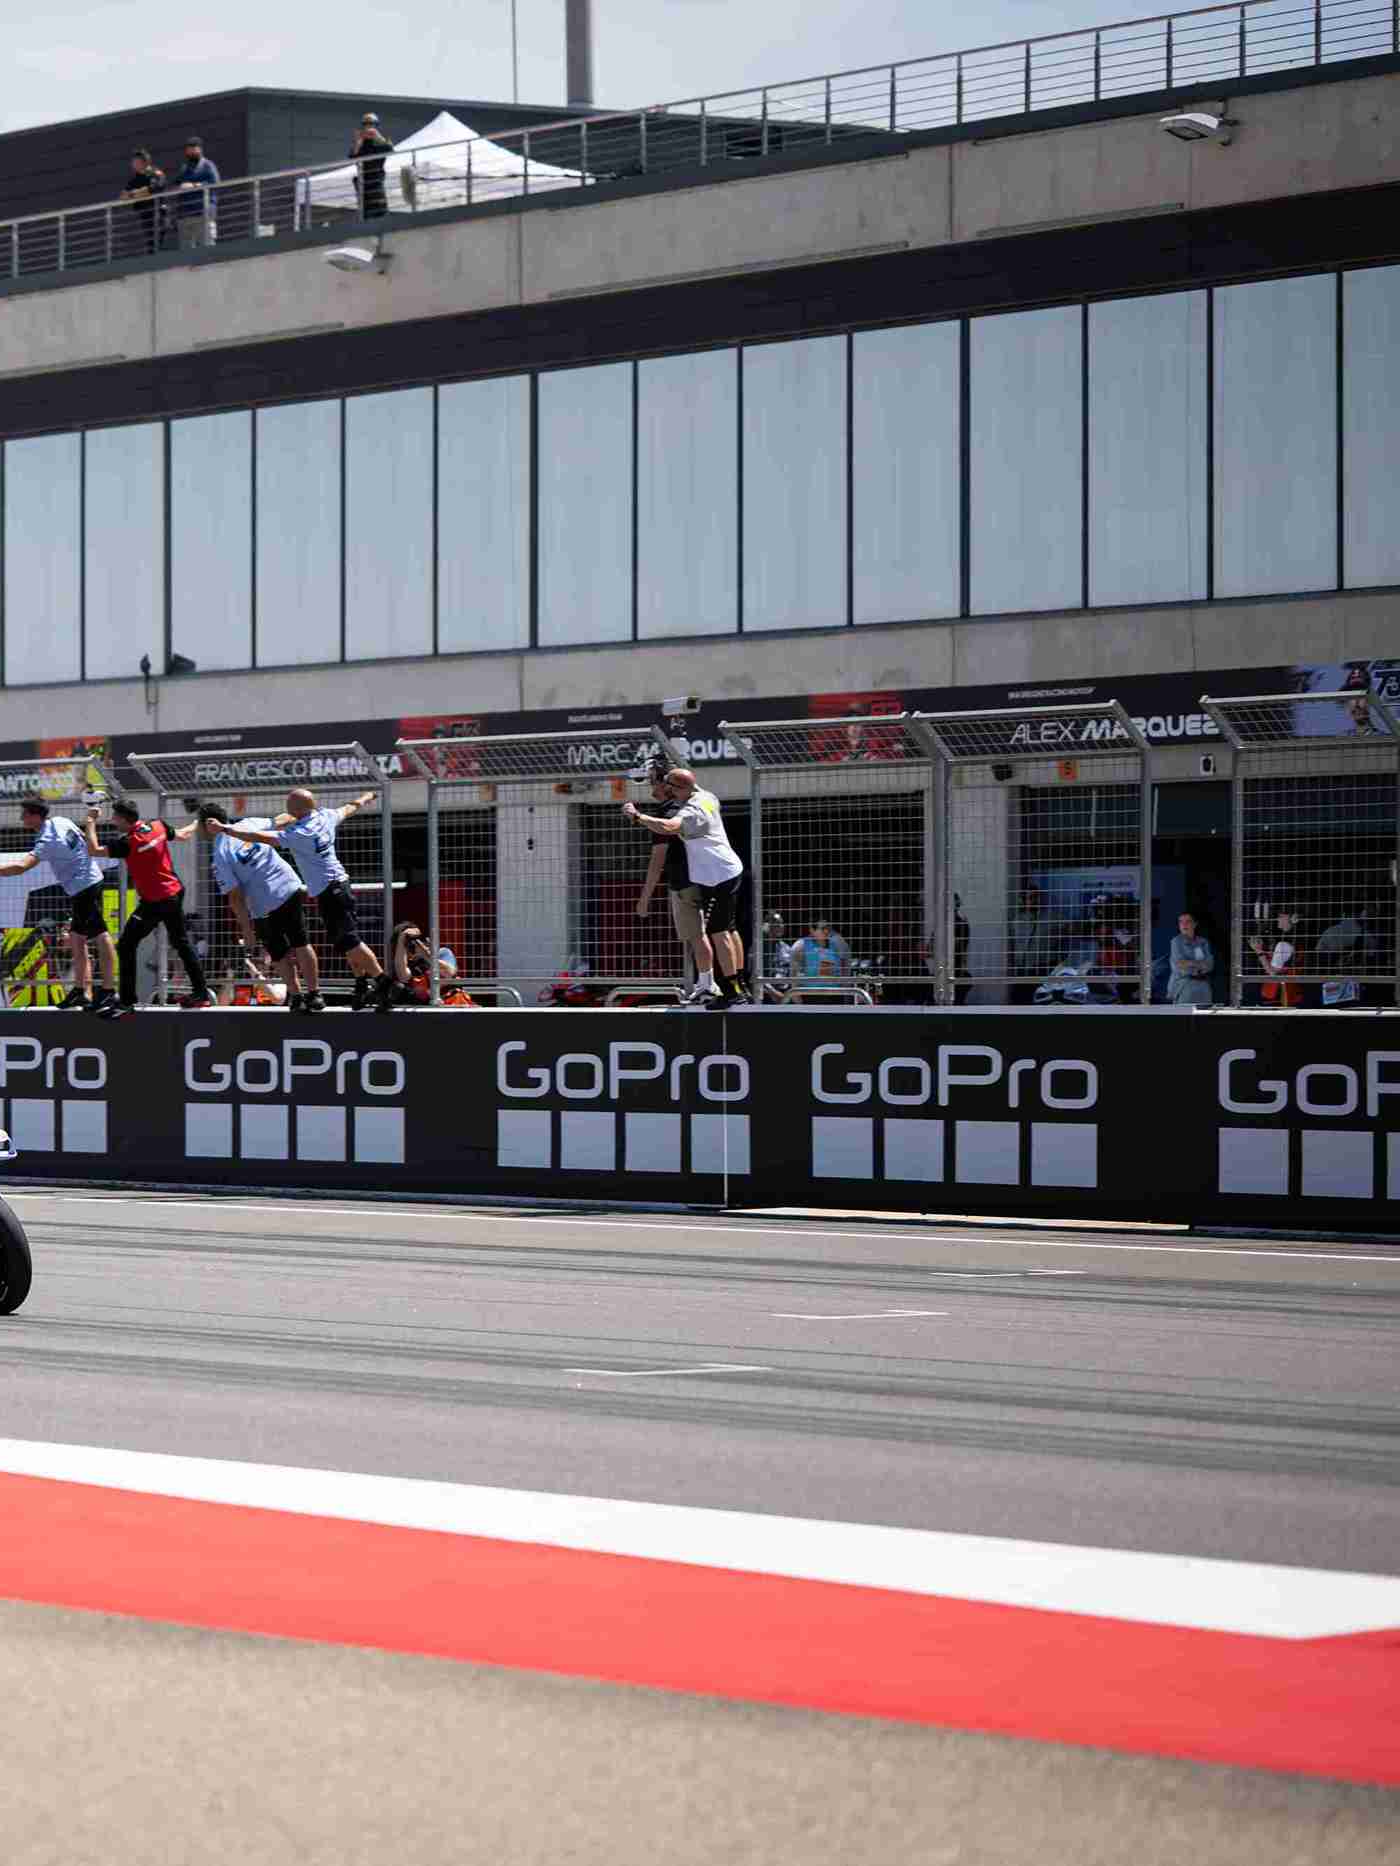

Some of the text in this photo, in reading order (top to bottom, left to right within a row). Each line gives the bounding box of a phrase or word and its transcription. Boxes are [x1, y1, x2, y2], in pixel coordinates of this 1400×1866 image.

[567, 738, 752, 765] MARC MRQUE
[1010, 721, 1076, 745] ALEX
[195, 753, 403, 782] FRANCESCO BAGNIA
[185, 1038, 405, 1095] GoPro
[497, 1040, 750, 1102] GoPro
[812, 1043, 1098, 1109] GoPro
